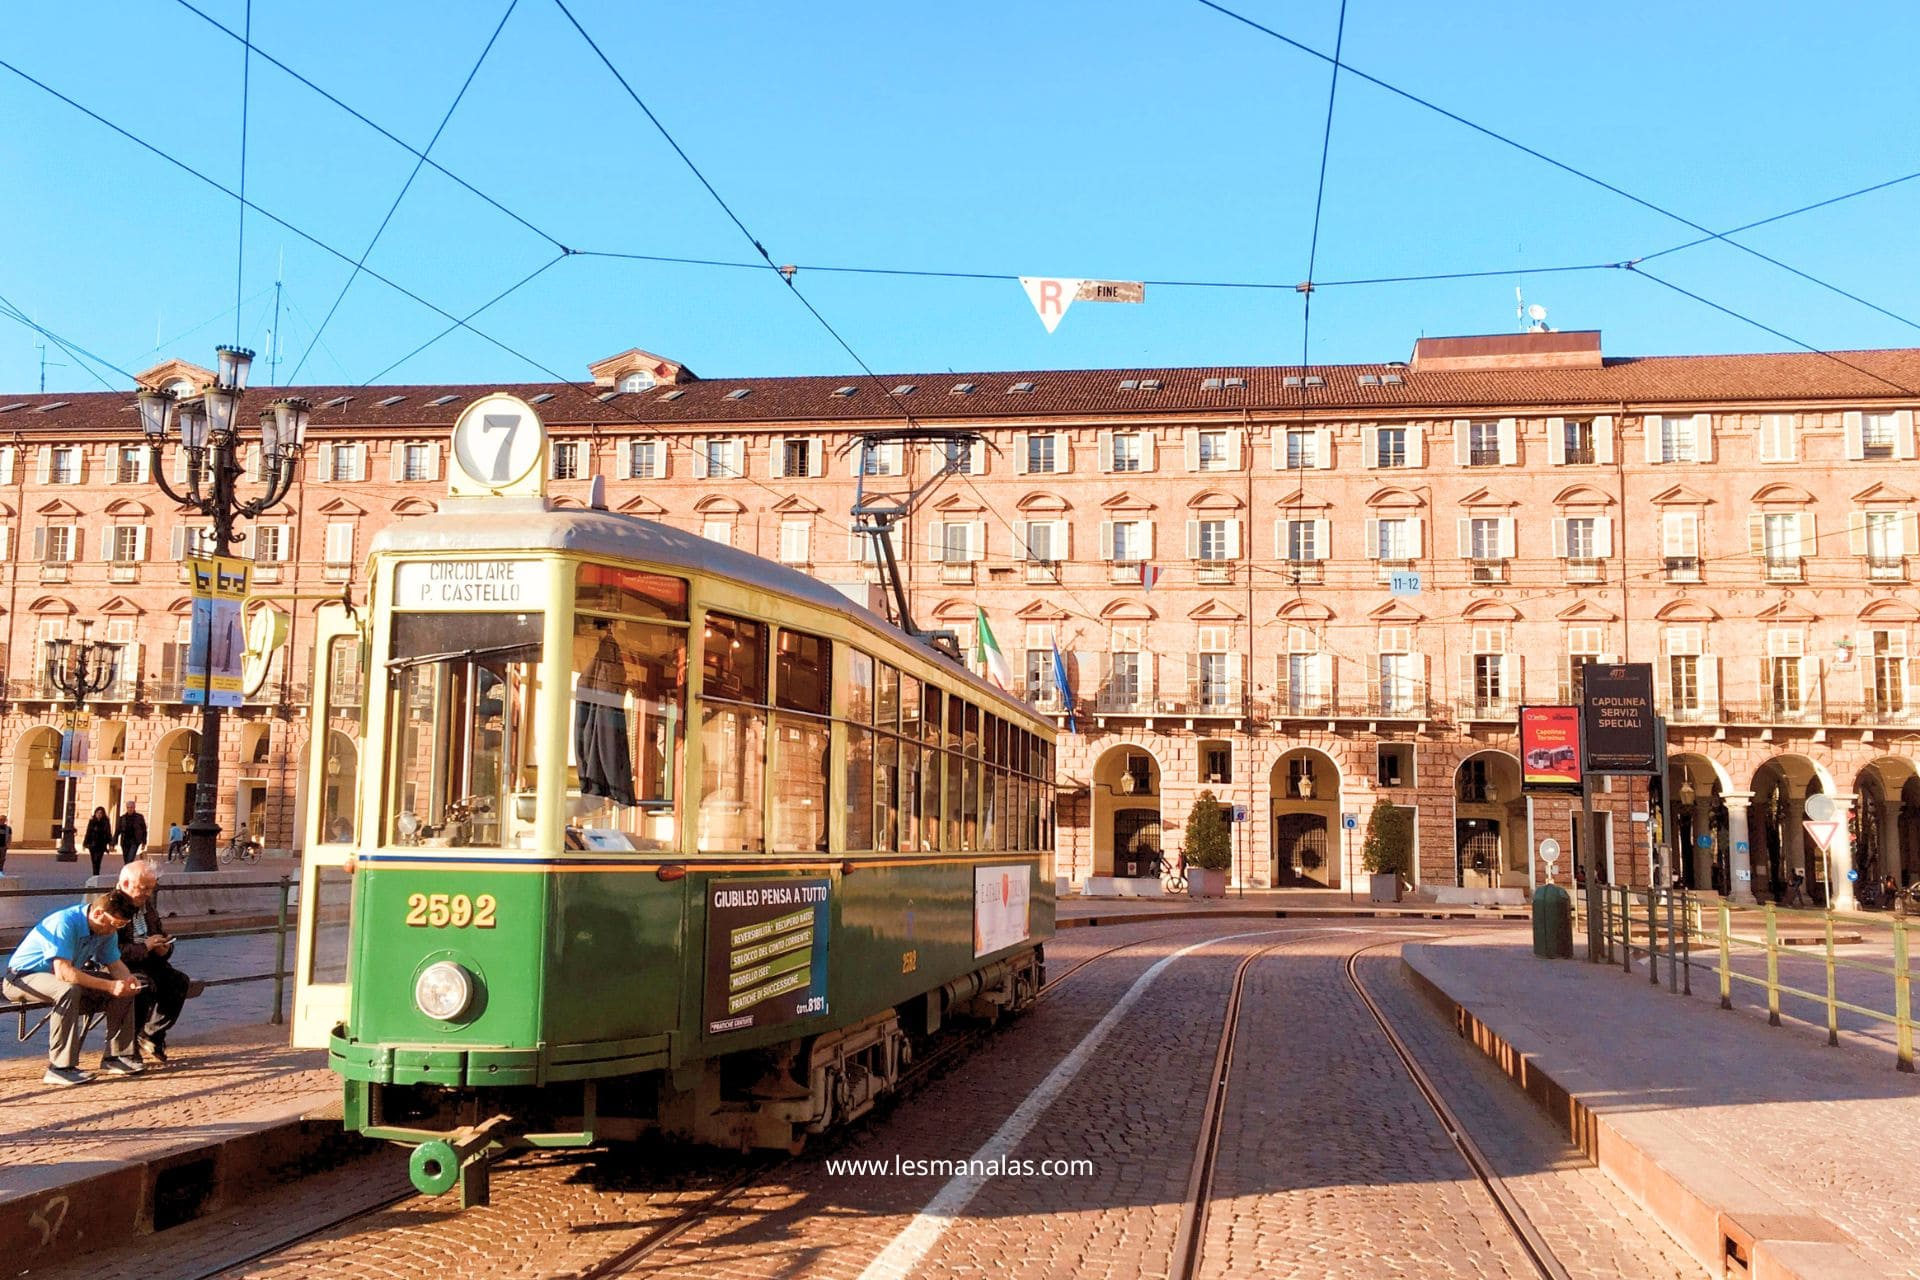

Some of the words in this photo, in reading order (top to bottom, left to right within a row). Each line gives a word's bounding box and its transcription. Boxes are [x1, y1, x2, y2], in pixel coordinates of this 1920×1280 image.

[1039, 280, 1063, 315] R
[1096, 285, 1119, 298] FINE
[482, 414, 522, 481] 7
[430, 561, 515, 580] CIRCOLARE
[420, 583, 433, 601] P.
[441, 583, 520, 601] CASTELLO
[1393, 577, 1420, 590] 11-12
[1591, 697, 1646, 706] CAPOLINEA
[1600, 708, 1639, 717] SERVIZI
[1598, 719, 1642, 728] SPECIALI
[714, 889, 759, 908] GIUBILEO
[761, 887, 793, 905] PENSA
[793, 887, 801, 903] A
[801, 886, 827, 902] TUTTO
[405, 893, 497, 929] 2592
[733, 949, 758, 966] SBLOCCO
[758, 946, 768, 958] DEL
[732, 970, 759, 988] MODELLO
[731, 991, 757, 1010] PRATICHE
[757, 988, 763, 999] DI
[763, 974, 799, 997] SUCCESSIONE
